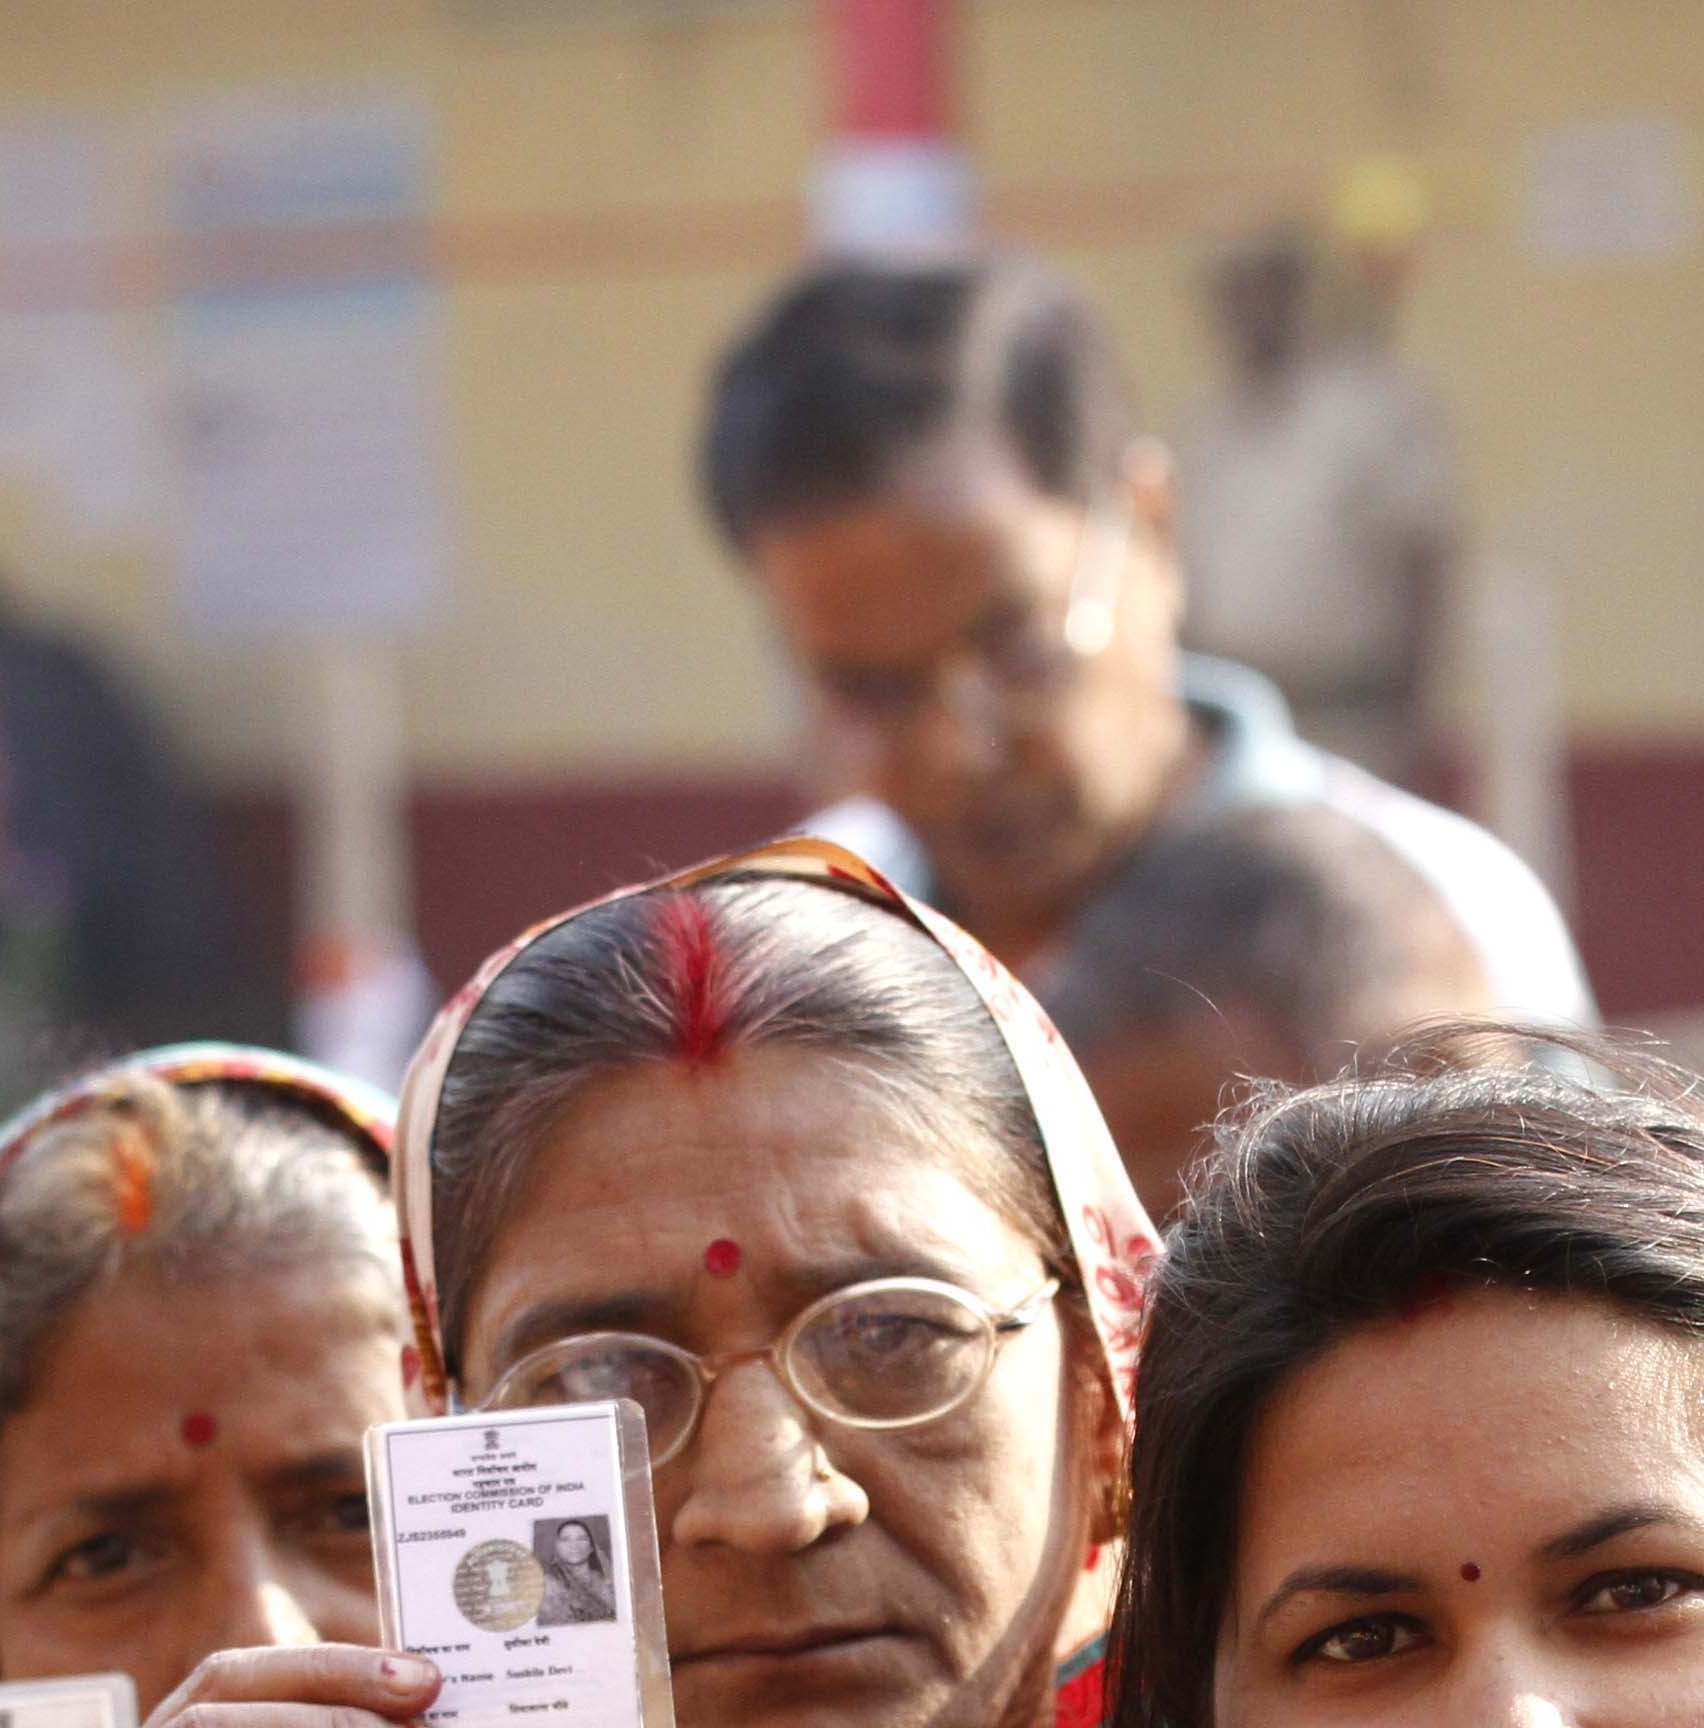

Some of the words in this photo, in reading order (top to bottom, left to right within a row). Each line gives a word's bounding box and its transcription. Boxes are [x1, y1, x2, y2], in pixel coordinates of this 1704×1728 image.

[408, 1493, 461, 1505] ELECTION
[465, 1487, 535, 1499] COMMISSION
[538, 1485, 552, 1493] OF
[556, 1482, 584, 1492] INDIA
[451, 1501, 504, 1513] IDENTITY
[508, 1498, 544, 1509] CARD
[548, 1665, 572, 1675] Devi
[461, 1673, 493, 1682] Name
